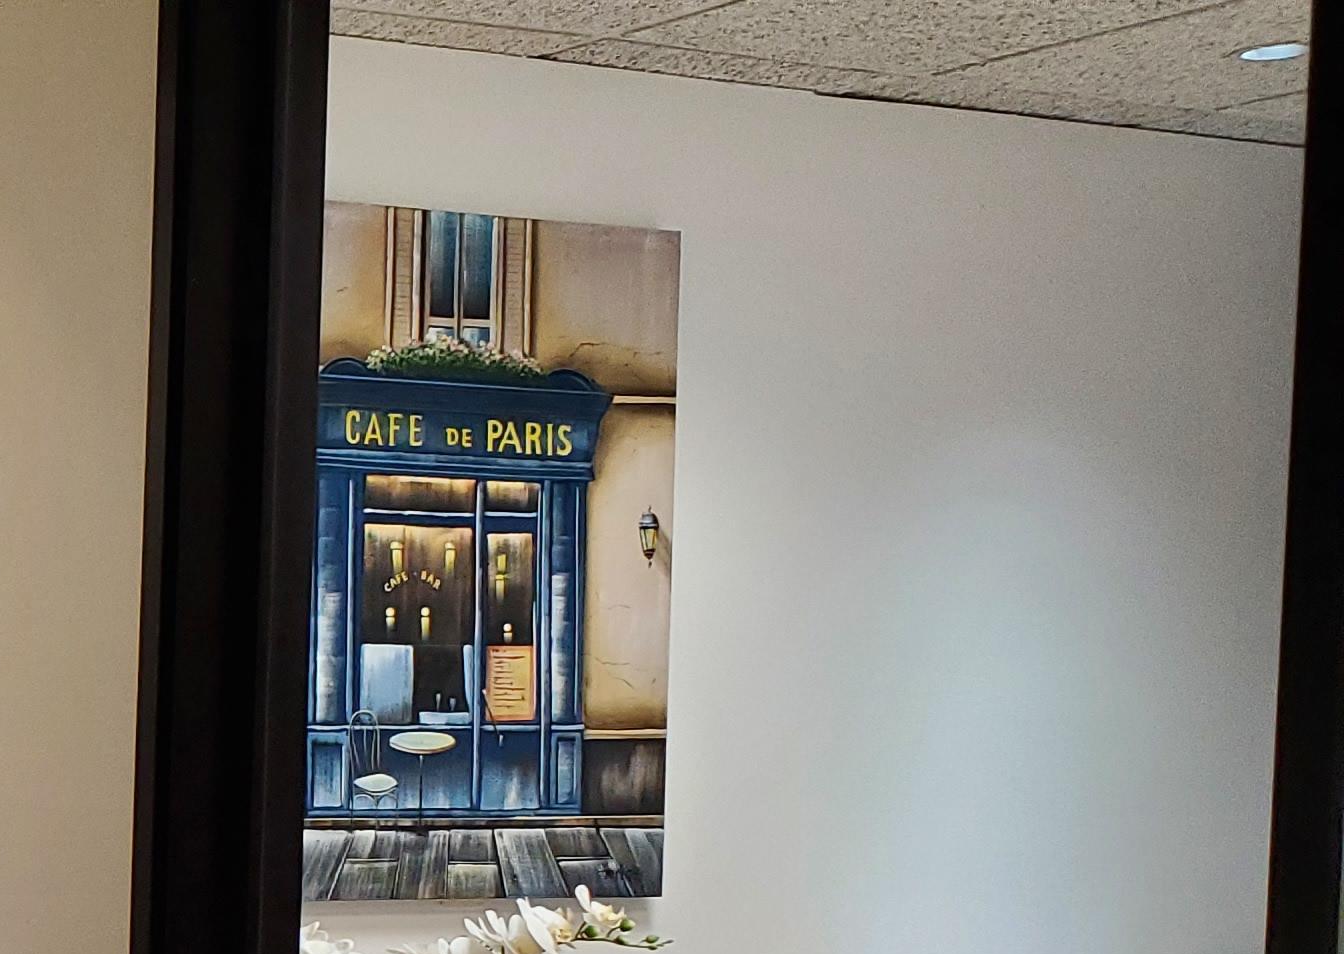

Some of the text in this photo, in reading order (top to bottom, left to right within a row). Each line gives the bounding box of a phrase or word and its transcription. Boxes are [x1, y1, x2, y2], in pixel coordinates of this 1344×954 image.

[345, 410, 573, 456] CAFE DE PARIS
[383, 570, 441, 592] CAFE BAR
